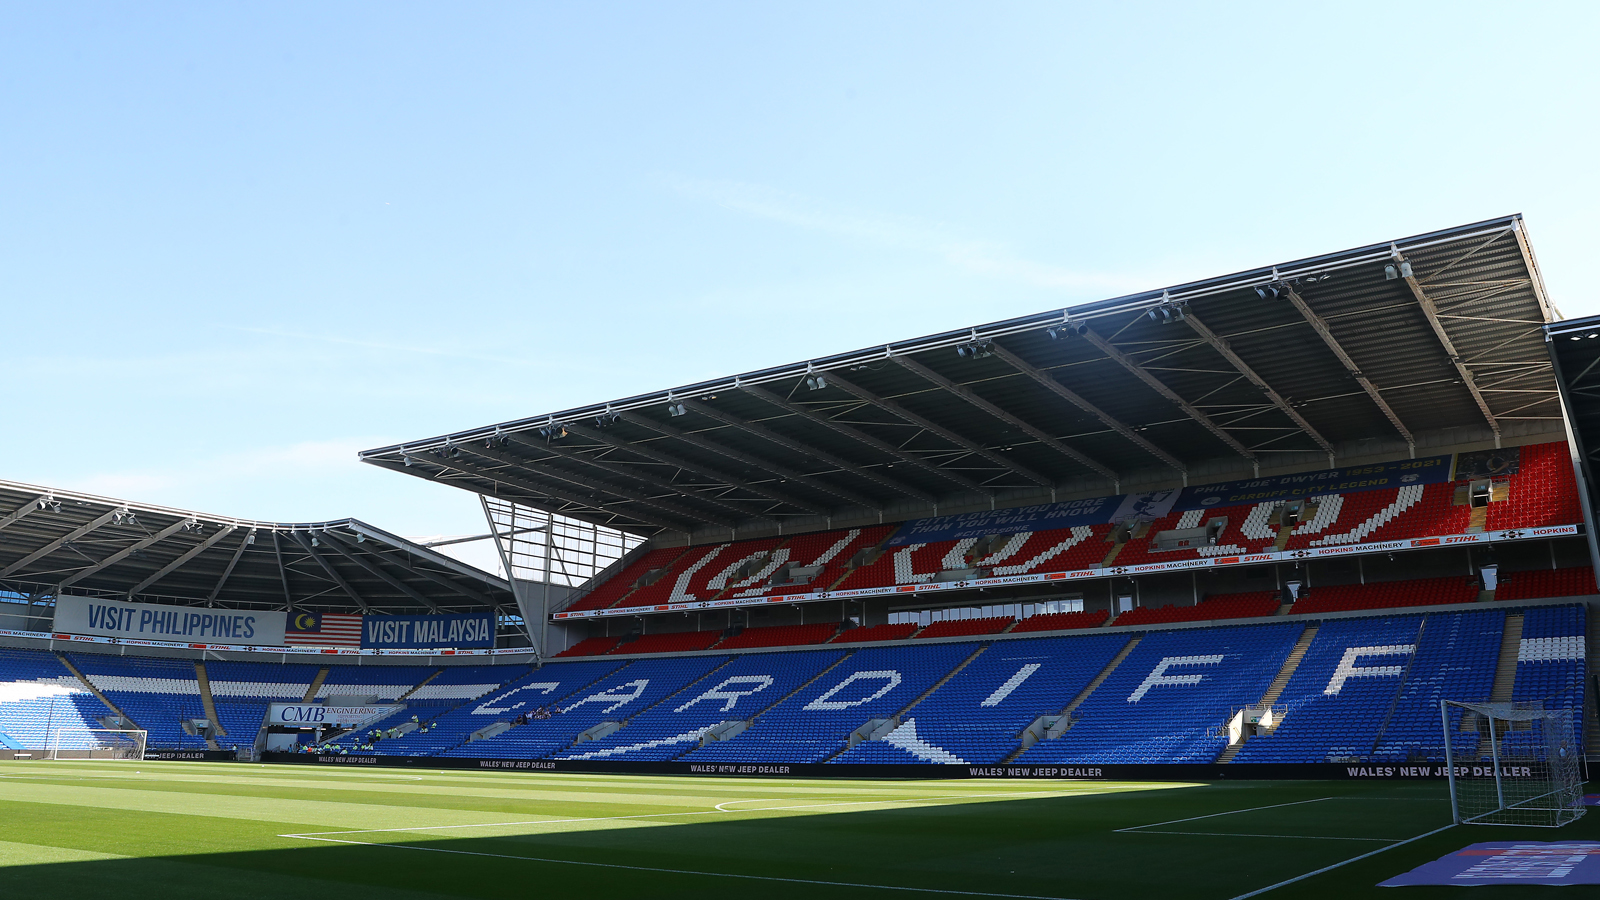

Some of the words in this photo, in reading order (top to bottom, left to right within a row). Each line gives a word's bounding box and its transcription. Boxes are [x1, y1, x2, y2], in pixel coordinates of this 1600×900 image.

[1194, 484, 1228, 494] PHIL
[1280, 471, 1339, 485] DWYER
[1346, 466, 1385, 476] 1953
[1400, 459, 1442, 470] 2021
[1229, 489, 1288, 502] CARDIFF
[1292, 485, 1325, 495] CITY
[1329, 478, 1388, 491] LEGEND
[914, 515, 955, 527] CITY
[956, 508, 1013, 522] LOVES
[1017, 504, 1052, 515] YOU
[1055, 497, 1107, 510] MORE
[910, 522, 954, 535] THAN
[957, 518, 991, 529] YOU
[995, 513, 1038, 525] WILL
[1044, 506, 1102, 519] KNOW
[1532, 526, 1575, 535] HOPKINS
[1445, 535, 1480, 544] STIHL
[1318, 546, 1354, 555] HOPKINS
[1355, 542, 1404, 552] MACHINERY
[1244, 554, 1274, 562] STIHL
[1134, 564, 1165, 572] HOPKINS
[1166, 559, 1208, 569] MACHINERY
[1002, 575, 1039, 583] MACHINERY
[1069, 570, 1096, 578] STIHL
[89, 604, 136, 632] VISIT
[139, 610, 256, 639] PHILIPPINES
[368, 620, 410, 643] VISIT
[413, 618, 489, 643] MALAYSIA
[281, 706, 327, 722] CMB
[719, 765, 736, 773] NEW
[737, 765, 757, 773] JEEP
[758, 766, 790, 774] DEALER
[969, 767, 1005, 776] WALES'
[1008, 767, 1030, 776] NEW
[1032, 768, 1058, 776] JEEP
[1060, 768, 1102, 777] DEALER
[1347, 766, 1396, 777] WALES'
[1400, 766, 1431, 777] NEW
[1434, 766, 1469, 777] JEEP
